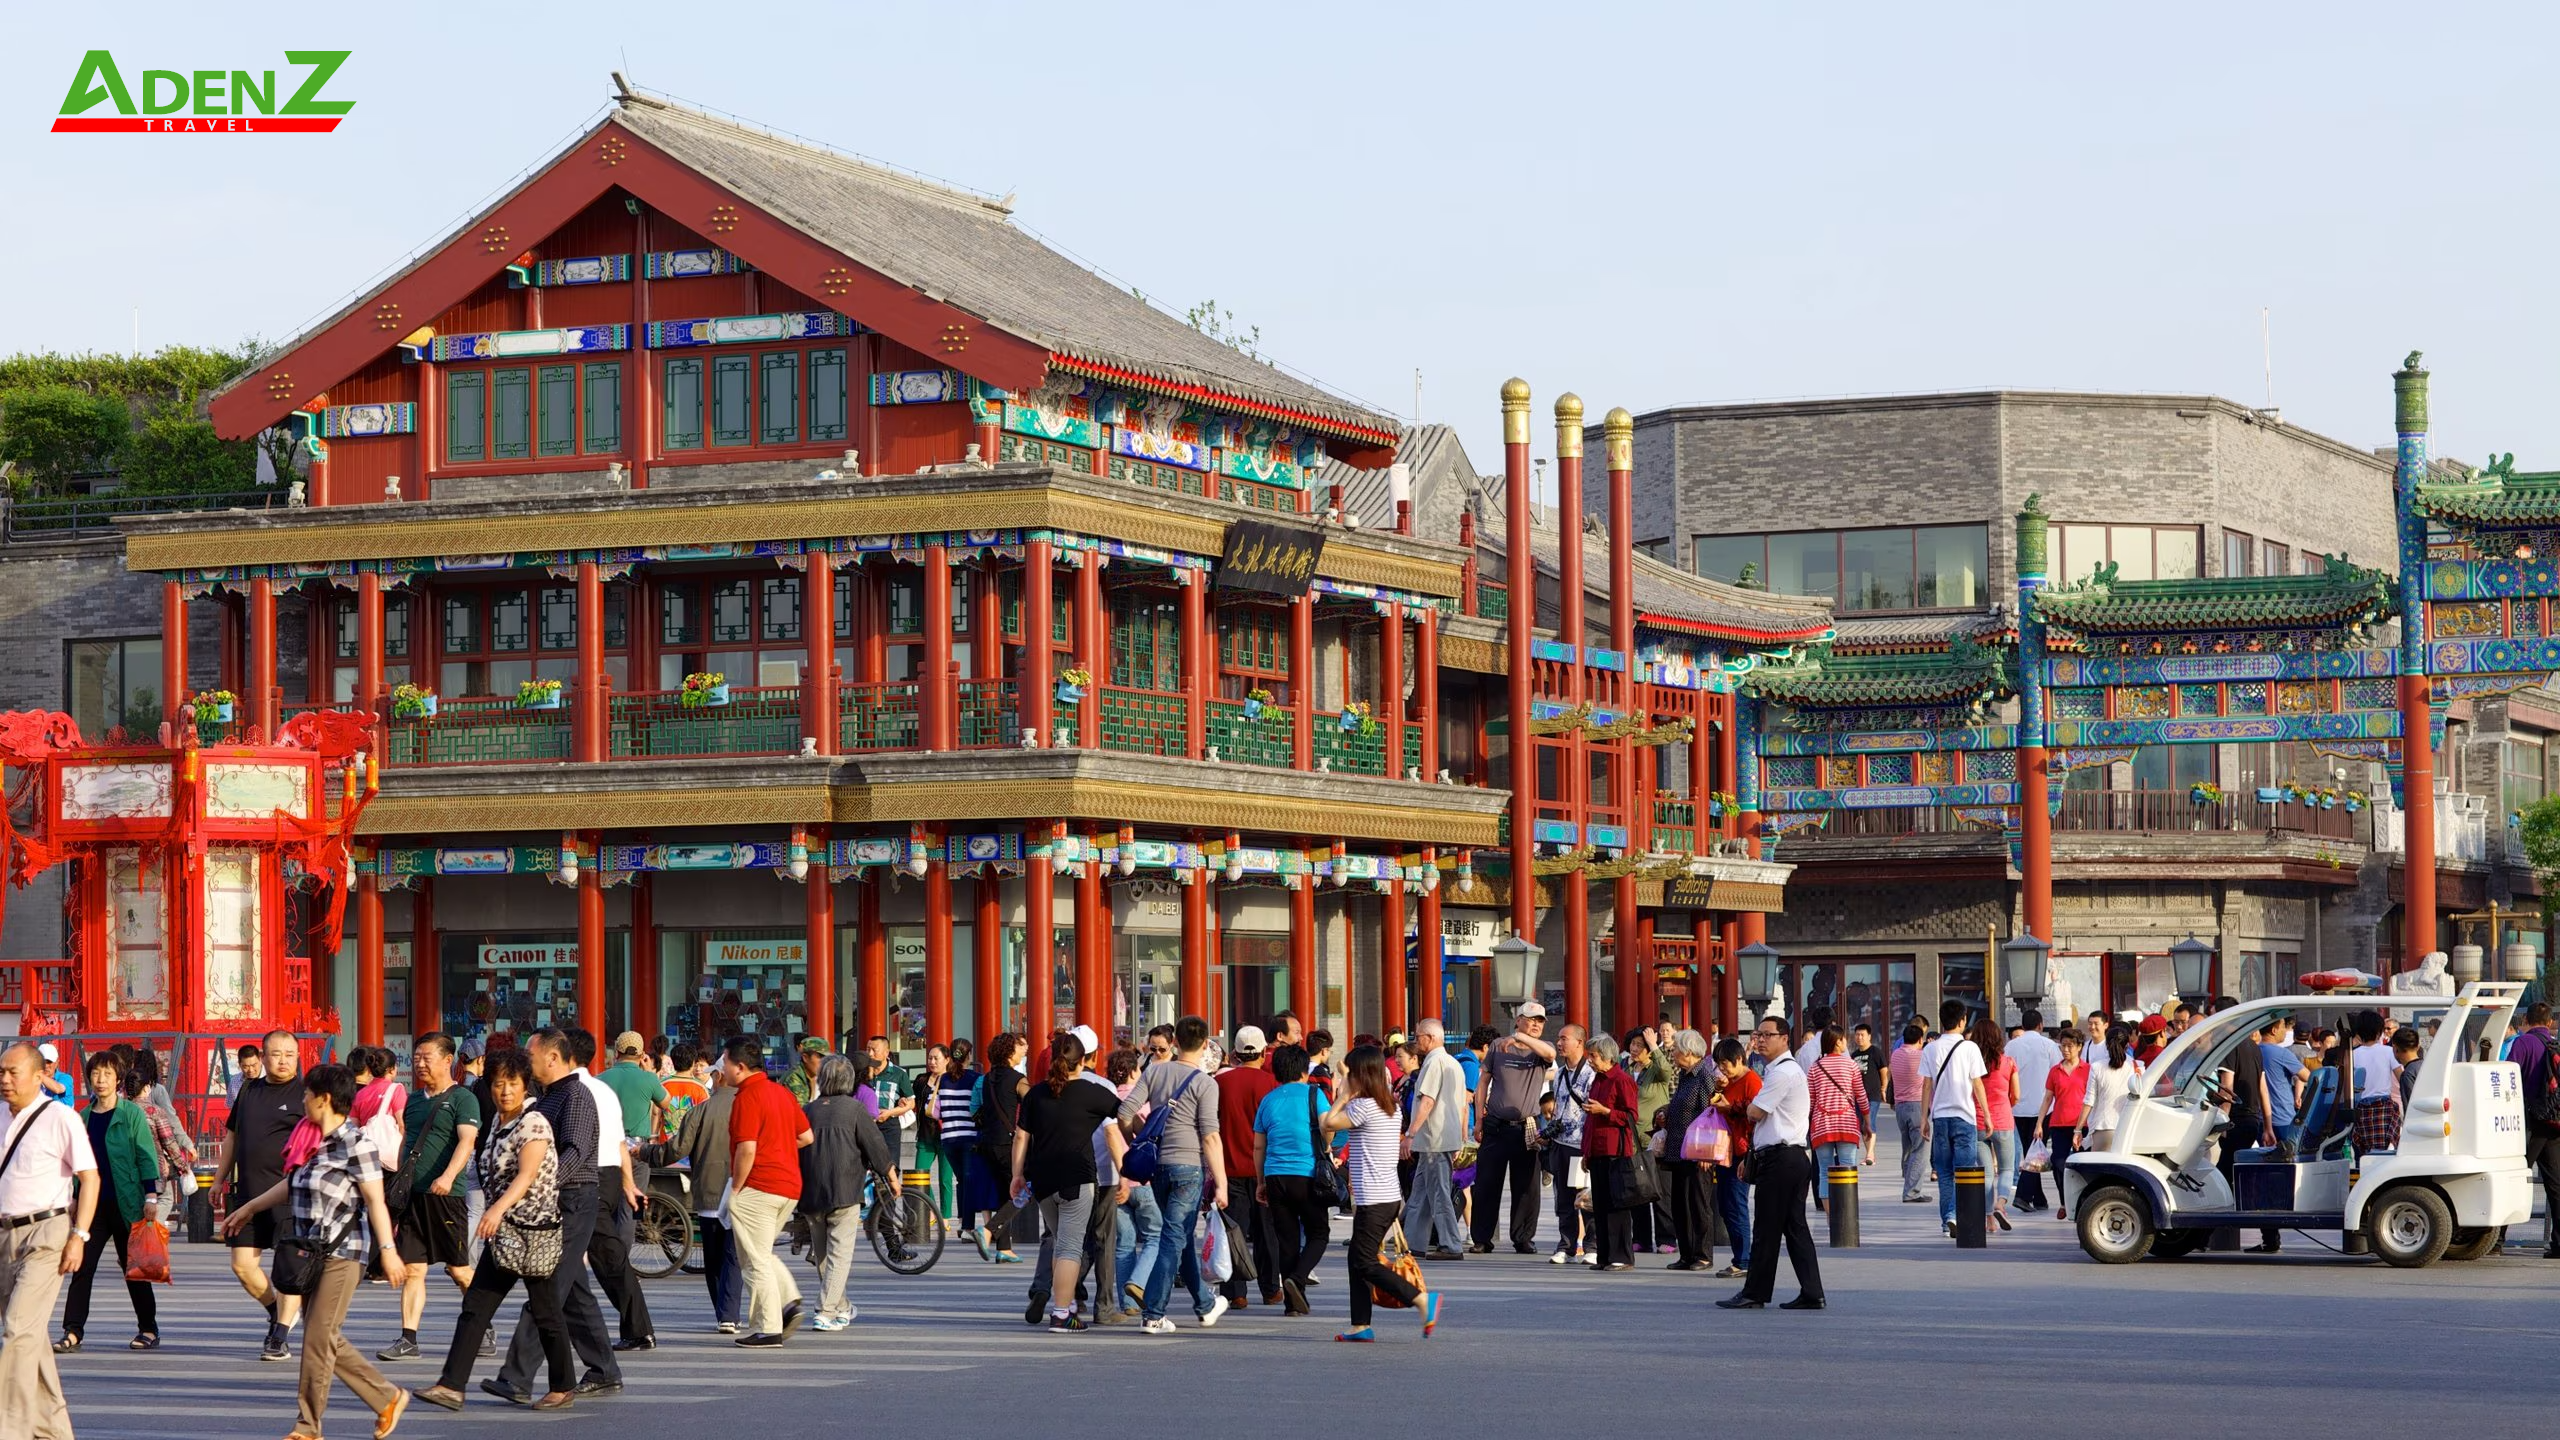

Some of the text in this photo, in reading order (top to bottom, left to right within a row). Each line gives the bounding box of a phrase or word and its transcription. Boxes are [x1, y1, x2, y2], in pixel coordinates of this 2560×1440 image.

[483, 948, 546, 964] Canon
[721, 945, 803, 960] Nikon 尼康
[2494, 1114, 2520, 1132] POLICE
